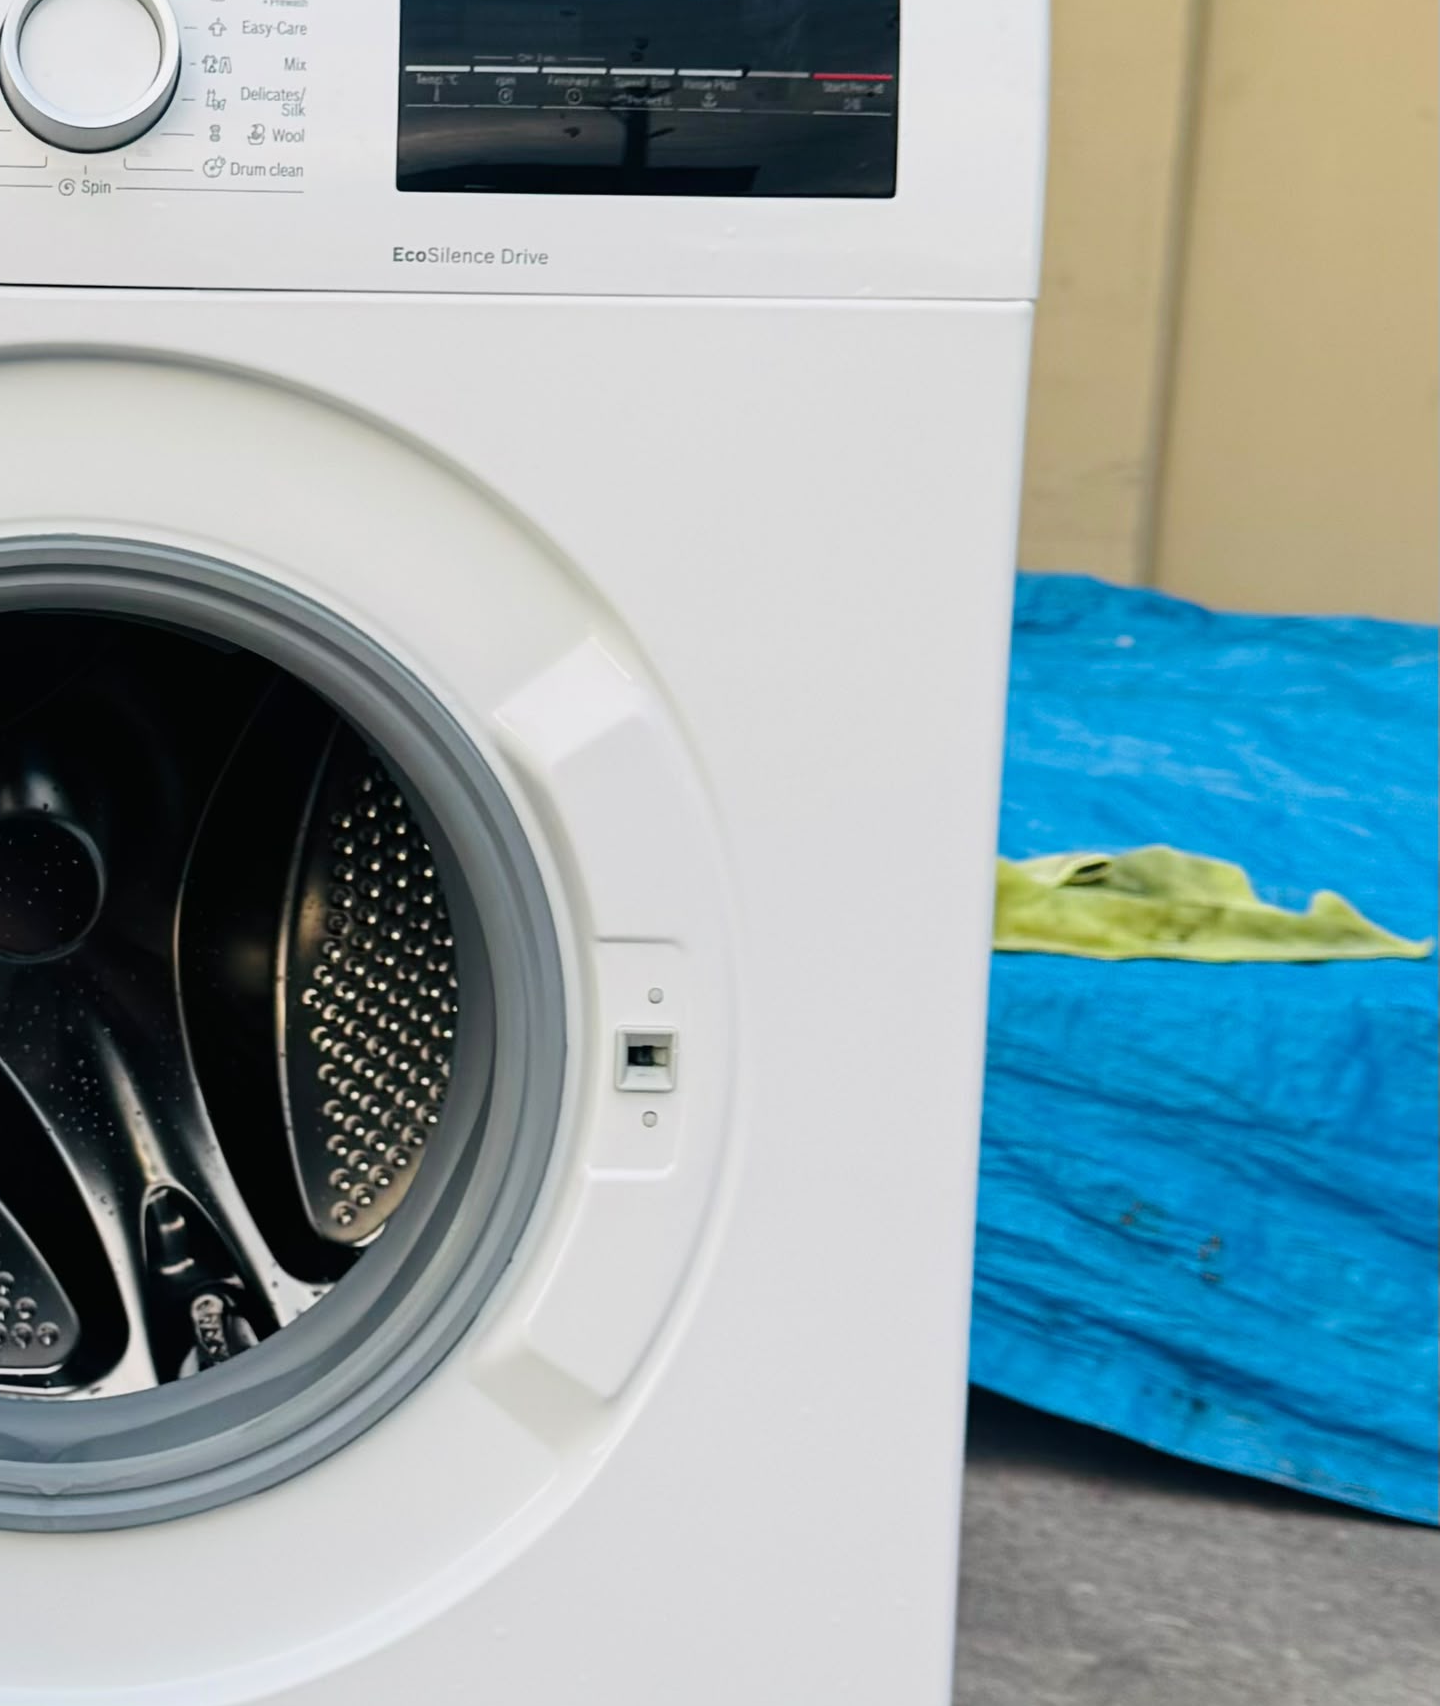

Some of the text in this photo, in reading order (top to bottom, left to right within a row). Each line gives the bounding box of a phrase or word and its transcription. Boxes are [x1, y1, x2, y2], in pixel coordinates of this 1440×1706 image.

[284, 57, 308, 72] Mix
[240, 86, 306, 105] Delicates/
[281, 102, 306, 117] Silk
[272, 128, 306, 143] Wool
[230, 162, 304, 178] Drum clean
[81, 179, 111, 197] Spin
[392, 246, 549, 265] EcoSilence Drive
